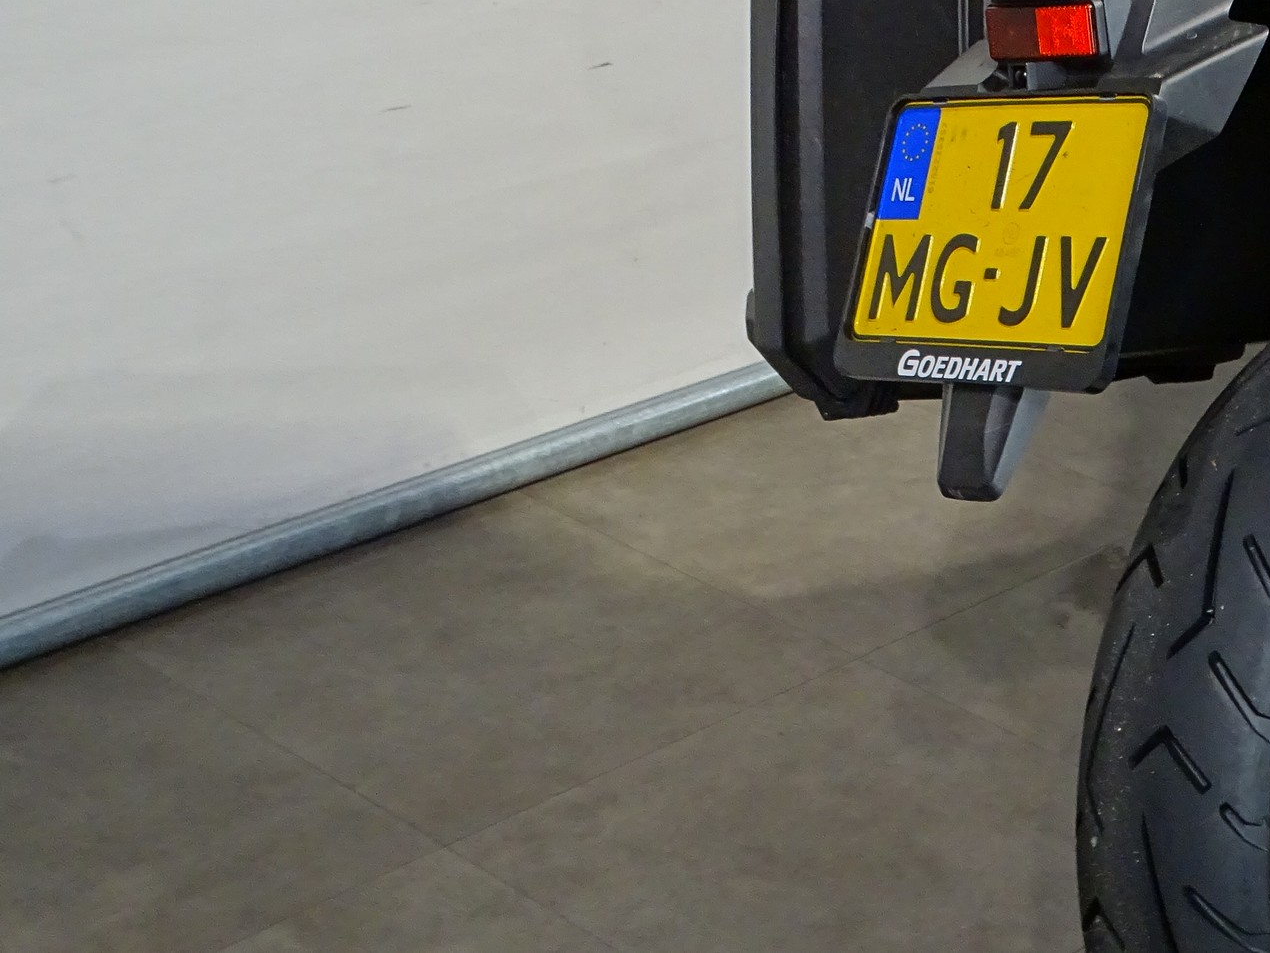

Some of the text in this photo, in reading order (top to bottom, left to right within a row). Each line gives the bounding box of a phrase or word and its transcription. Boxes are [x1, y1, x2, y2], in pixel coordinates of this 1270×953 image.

[890, 177, 915, 202] NL
[990, 120, 1075, 210] 17
[867, 233, 1108, 329] MG-JV
[897, 348, 1023, 383] GOEDHART
